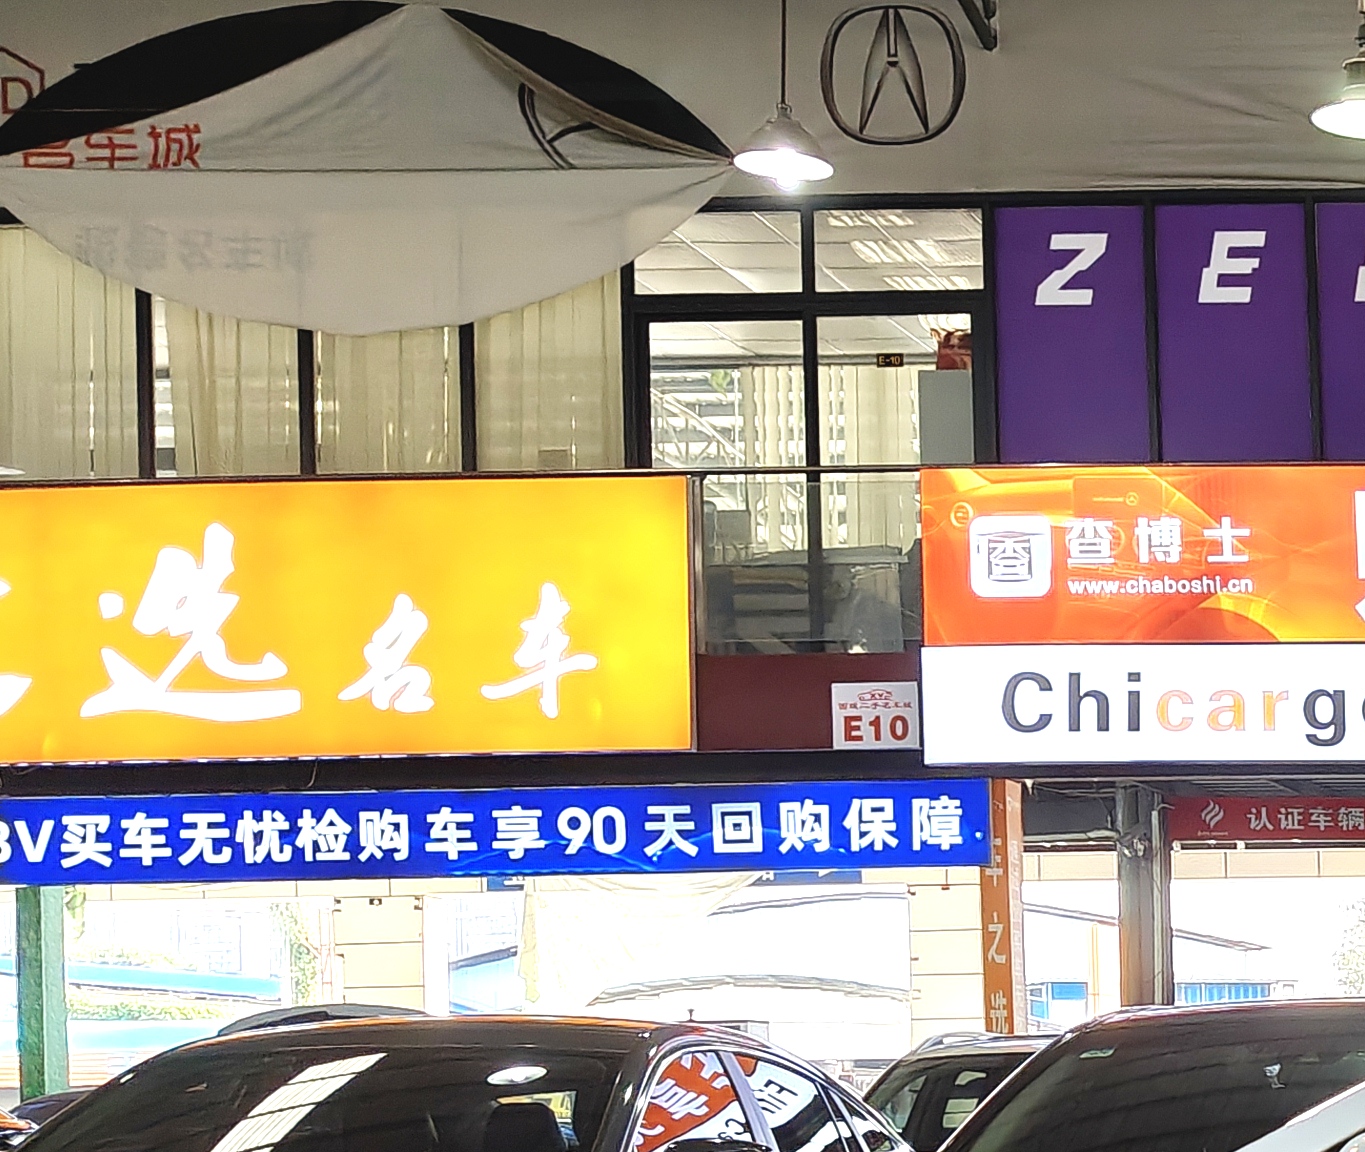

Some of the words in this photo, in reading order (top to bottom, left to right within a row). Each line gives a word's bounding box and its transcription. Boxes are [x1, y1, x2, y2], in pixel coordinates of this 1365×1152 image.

[1065, 516, 1252, 565] 查博士
[1067, 575, 1253, 595] www.chaboshi.cn
[843, 714, 909, 742] E10
[1247, 805, 1365, 831] 认证车辆
